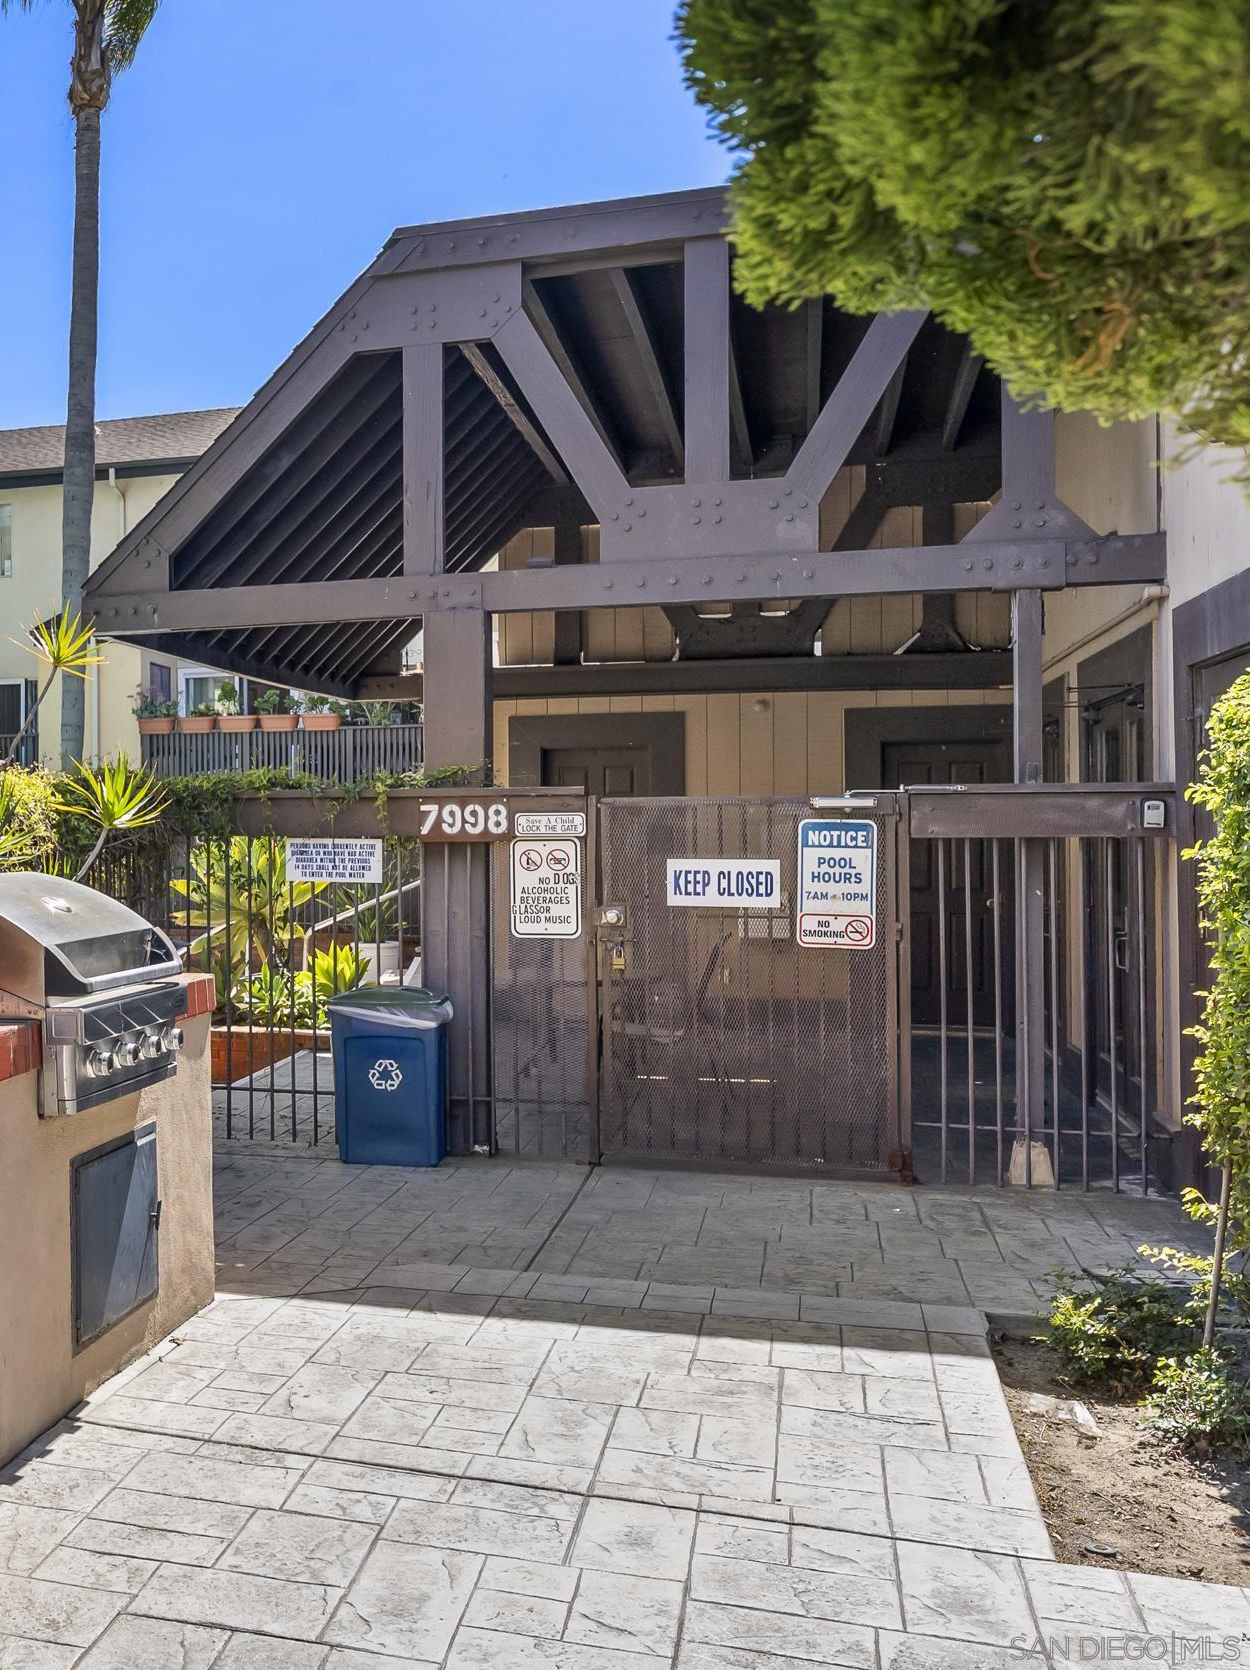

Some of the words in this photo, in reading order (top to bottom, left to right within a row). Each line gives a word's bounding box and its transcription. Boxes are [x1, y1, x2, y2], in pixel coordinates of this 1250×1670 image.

[419, 803, 509, 835] 7998
[808, 830, 866, 847] NOTICE
[817, 856, 856, 869] POOL
[538, 876, 550, 886] NO
[811, 872, 862, 884] HOURS
[674, 870, 711, 896] KEEP
[717, 870, 774, 898] CLOSED
[521, 886, 568, 894] ALCOHOLIC
[520, 896, 570, 904] BEVERAGES
[806, 892, 828, 900] 7AM
[842, 892, 868, 902] 10PM
[545, 916, 572, 924] MUSIC
[818, 920, 830, 928] NO
[802, 930, 845, 938] SMOKING
